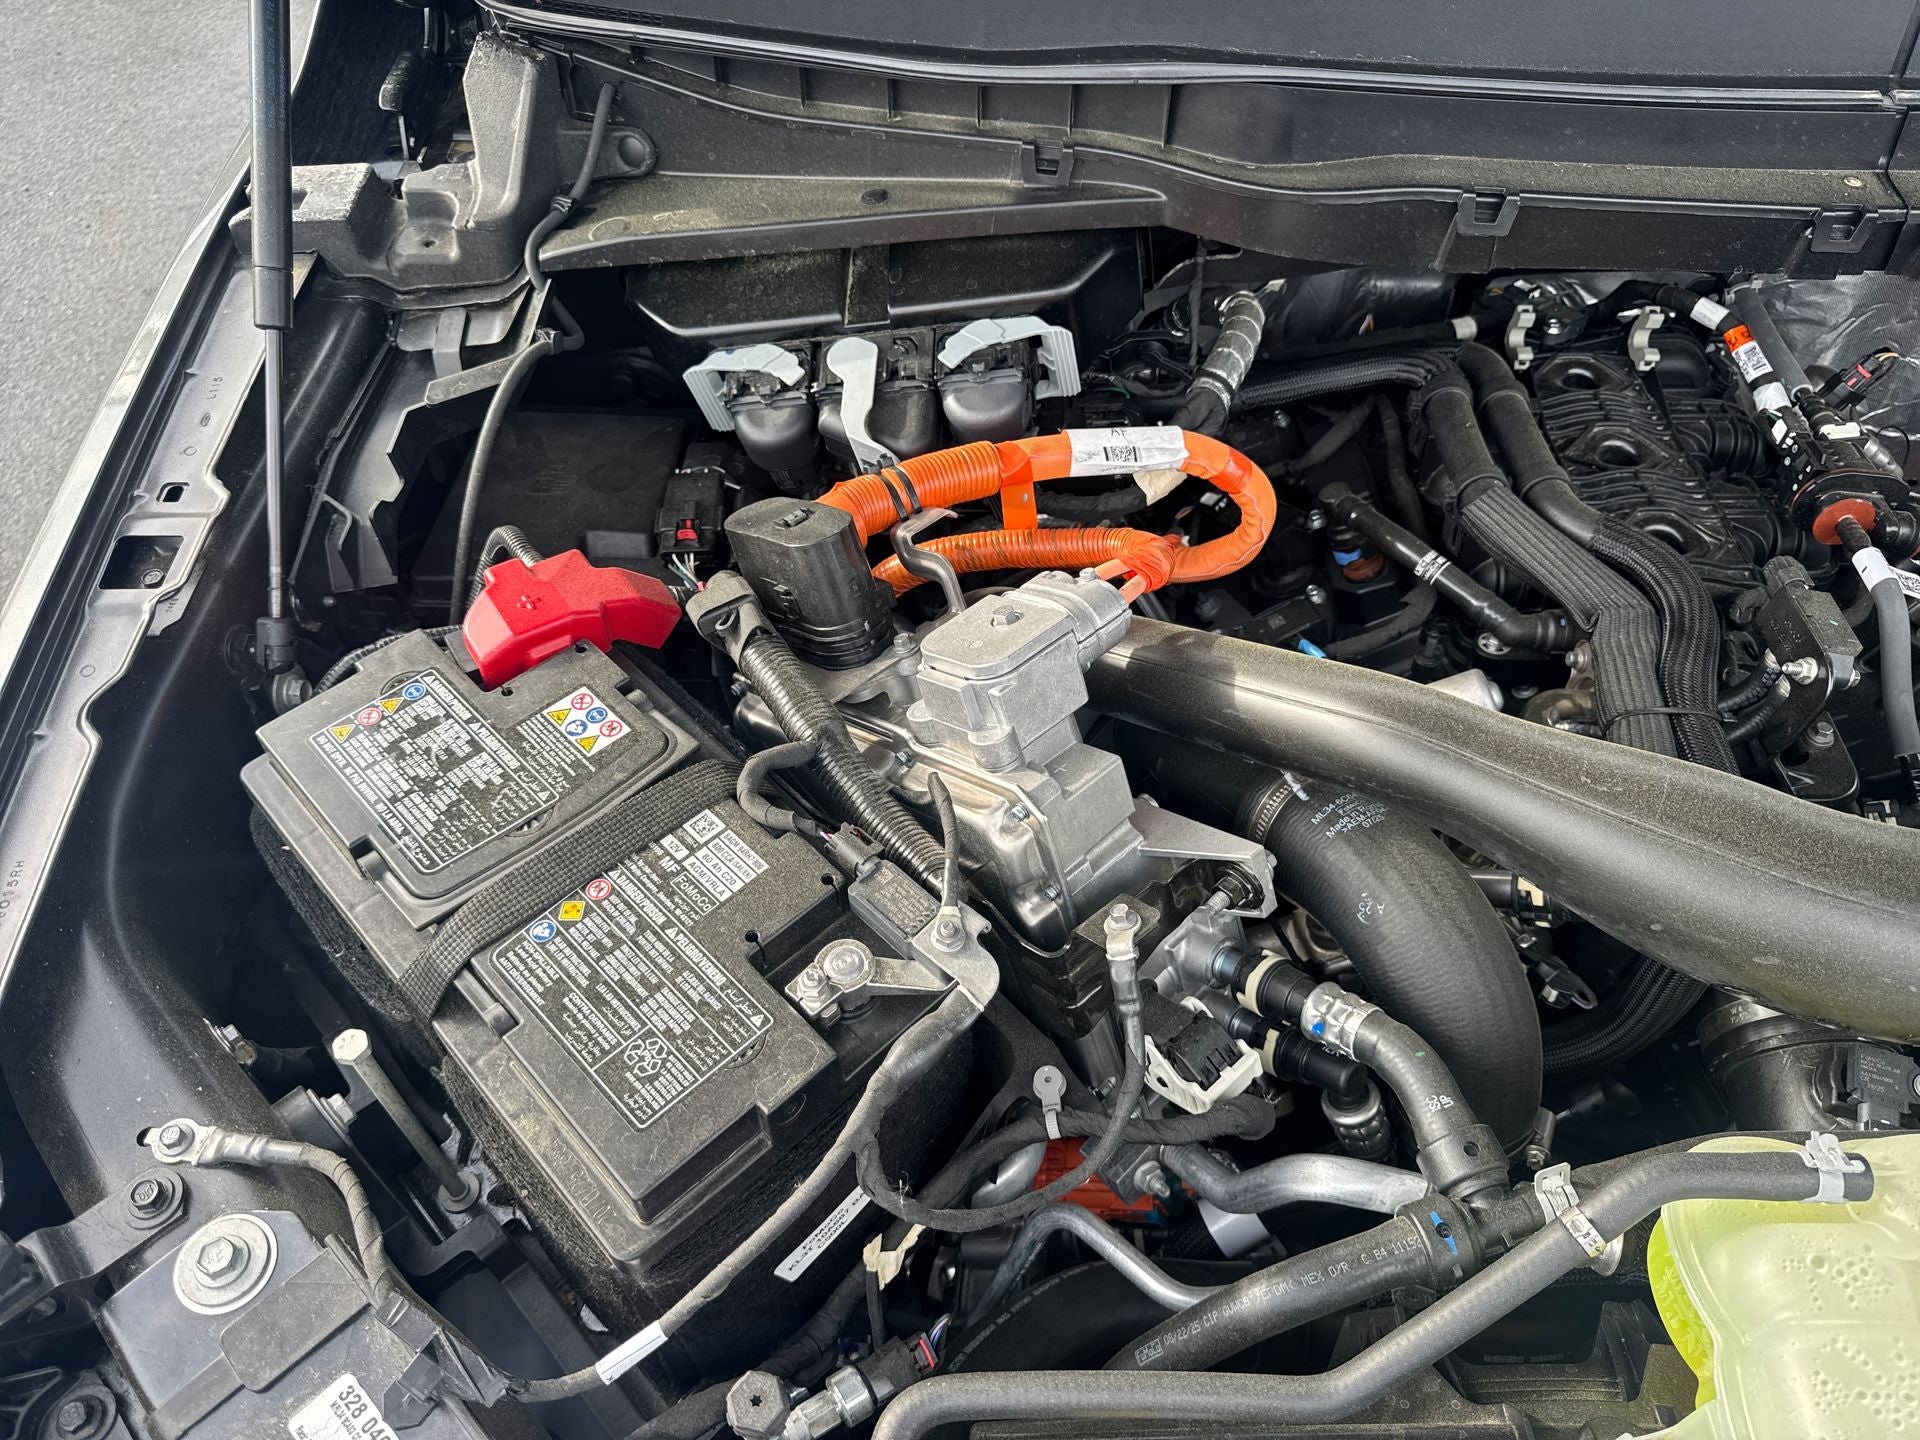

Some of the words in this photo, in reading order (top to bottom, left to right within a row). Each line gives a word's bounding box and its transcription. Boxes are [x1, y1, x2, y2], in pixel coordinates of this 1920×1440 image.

[1325, 817, 1351, 838] Made
[666, 839, 683, 854] 12V
[657, 855, 681, 875] MF
[687, 860, 726, 897] AGM/VRLA
[710, 861, 723, 873] Ah
[720, 870, 737, 886] C20
[614, 874, 667, 925] DANGER/POISON
[674, 875, 714, 912] FoMoCo
[521, 939, 560, 981] NON-SPILLABLE
[672, 932, 727, 986] PELIGRO/VENENO
[568, 991, 591, 1015] CONTRA
[587, 1012, 618, 1045] DERRAMES
[640, 1049, 653, 1062] Pb
[802, 1208, 844, 1249] FoMoCo
[1301, 1270, 1324, 1287] MEX
[338, 1385, 368, 1419] 328
